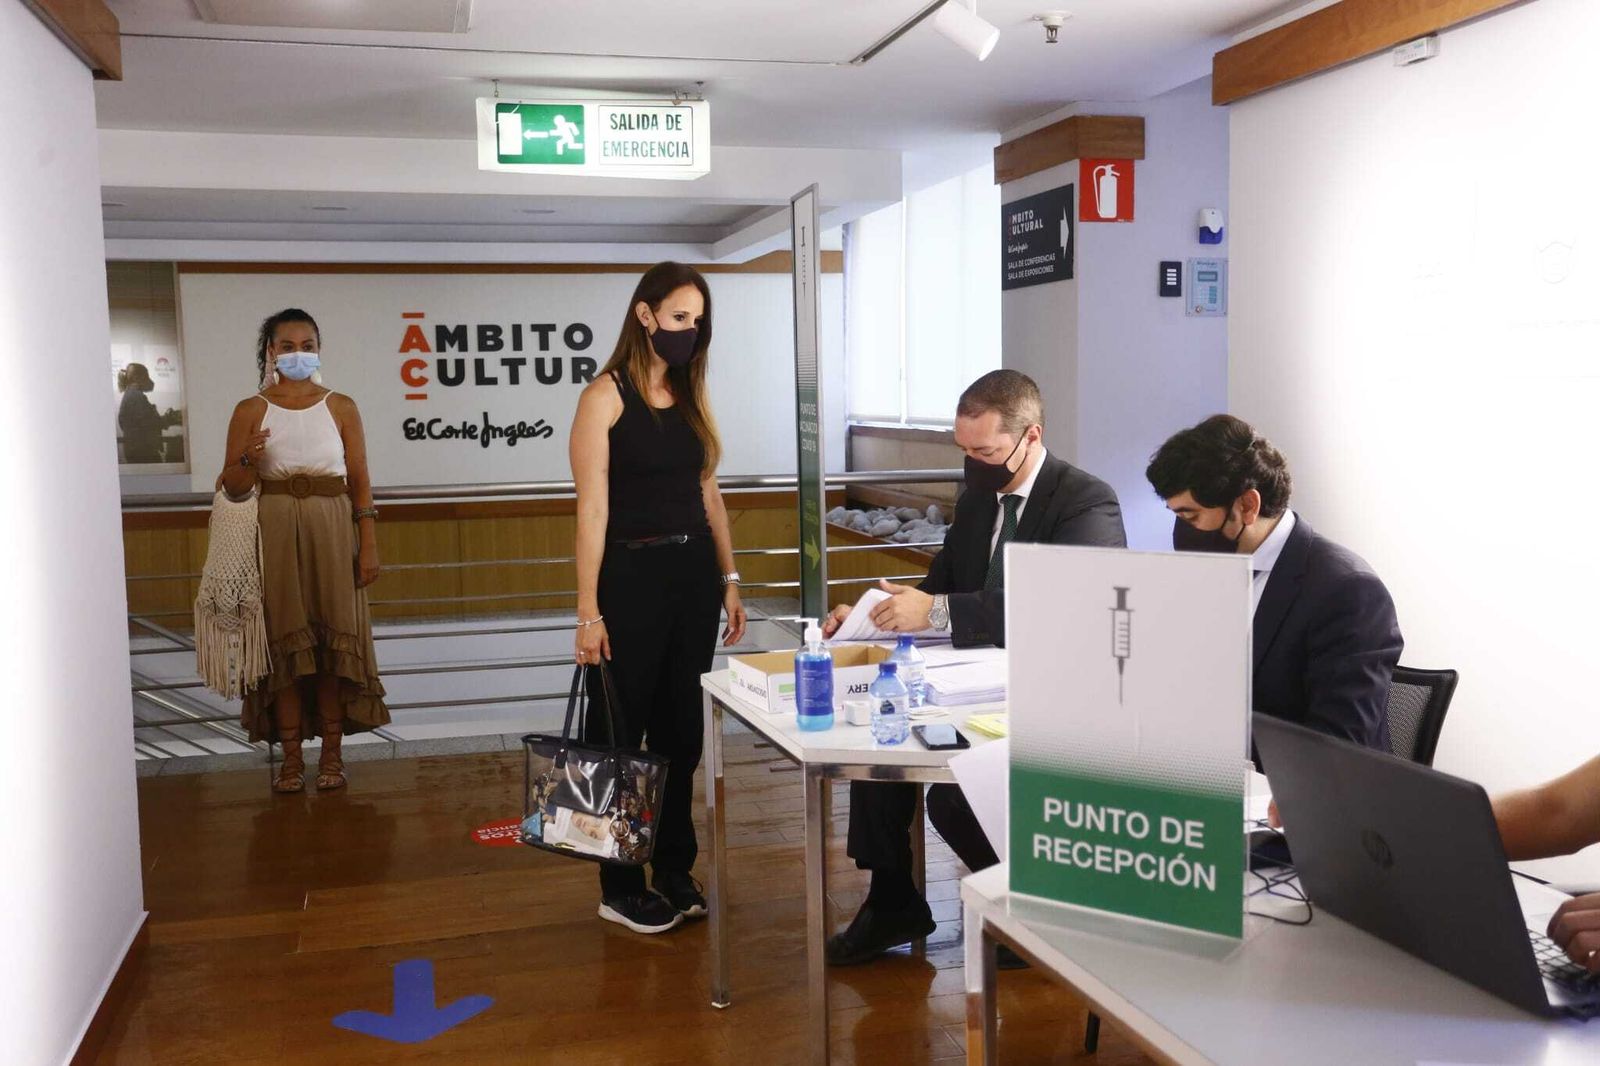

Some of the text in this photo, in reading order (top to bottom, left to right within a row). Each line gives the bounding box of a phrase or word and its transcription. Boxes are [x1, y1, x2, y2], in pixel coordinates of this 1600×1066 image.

[610, 113, 682, 131] SALIDA DE
[603, 140, 689, 158] EMERGENCIA
[400, 356, 598, 388] CULTUR
[402, 411, 554, 448] El Corte Inglés
[847, 683, 869, 695] ERY
[1044, 797, 1205, 849] PUNTO DE
[1033, 833, 1216, 892] RECEPCIÓN
